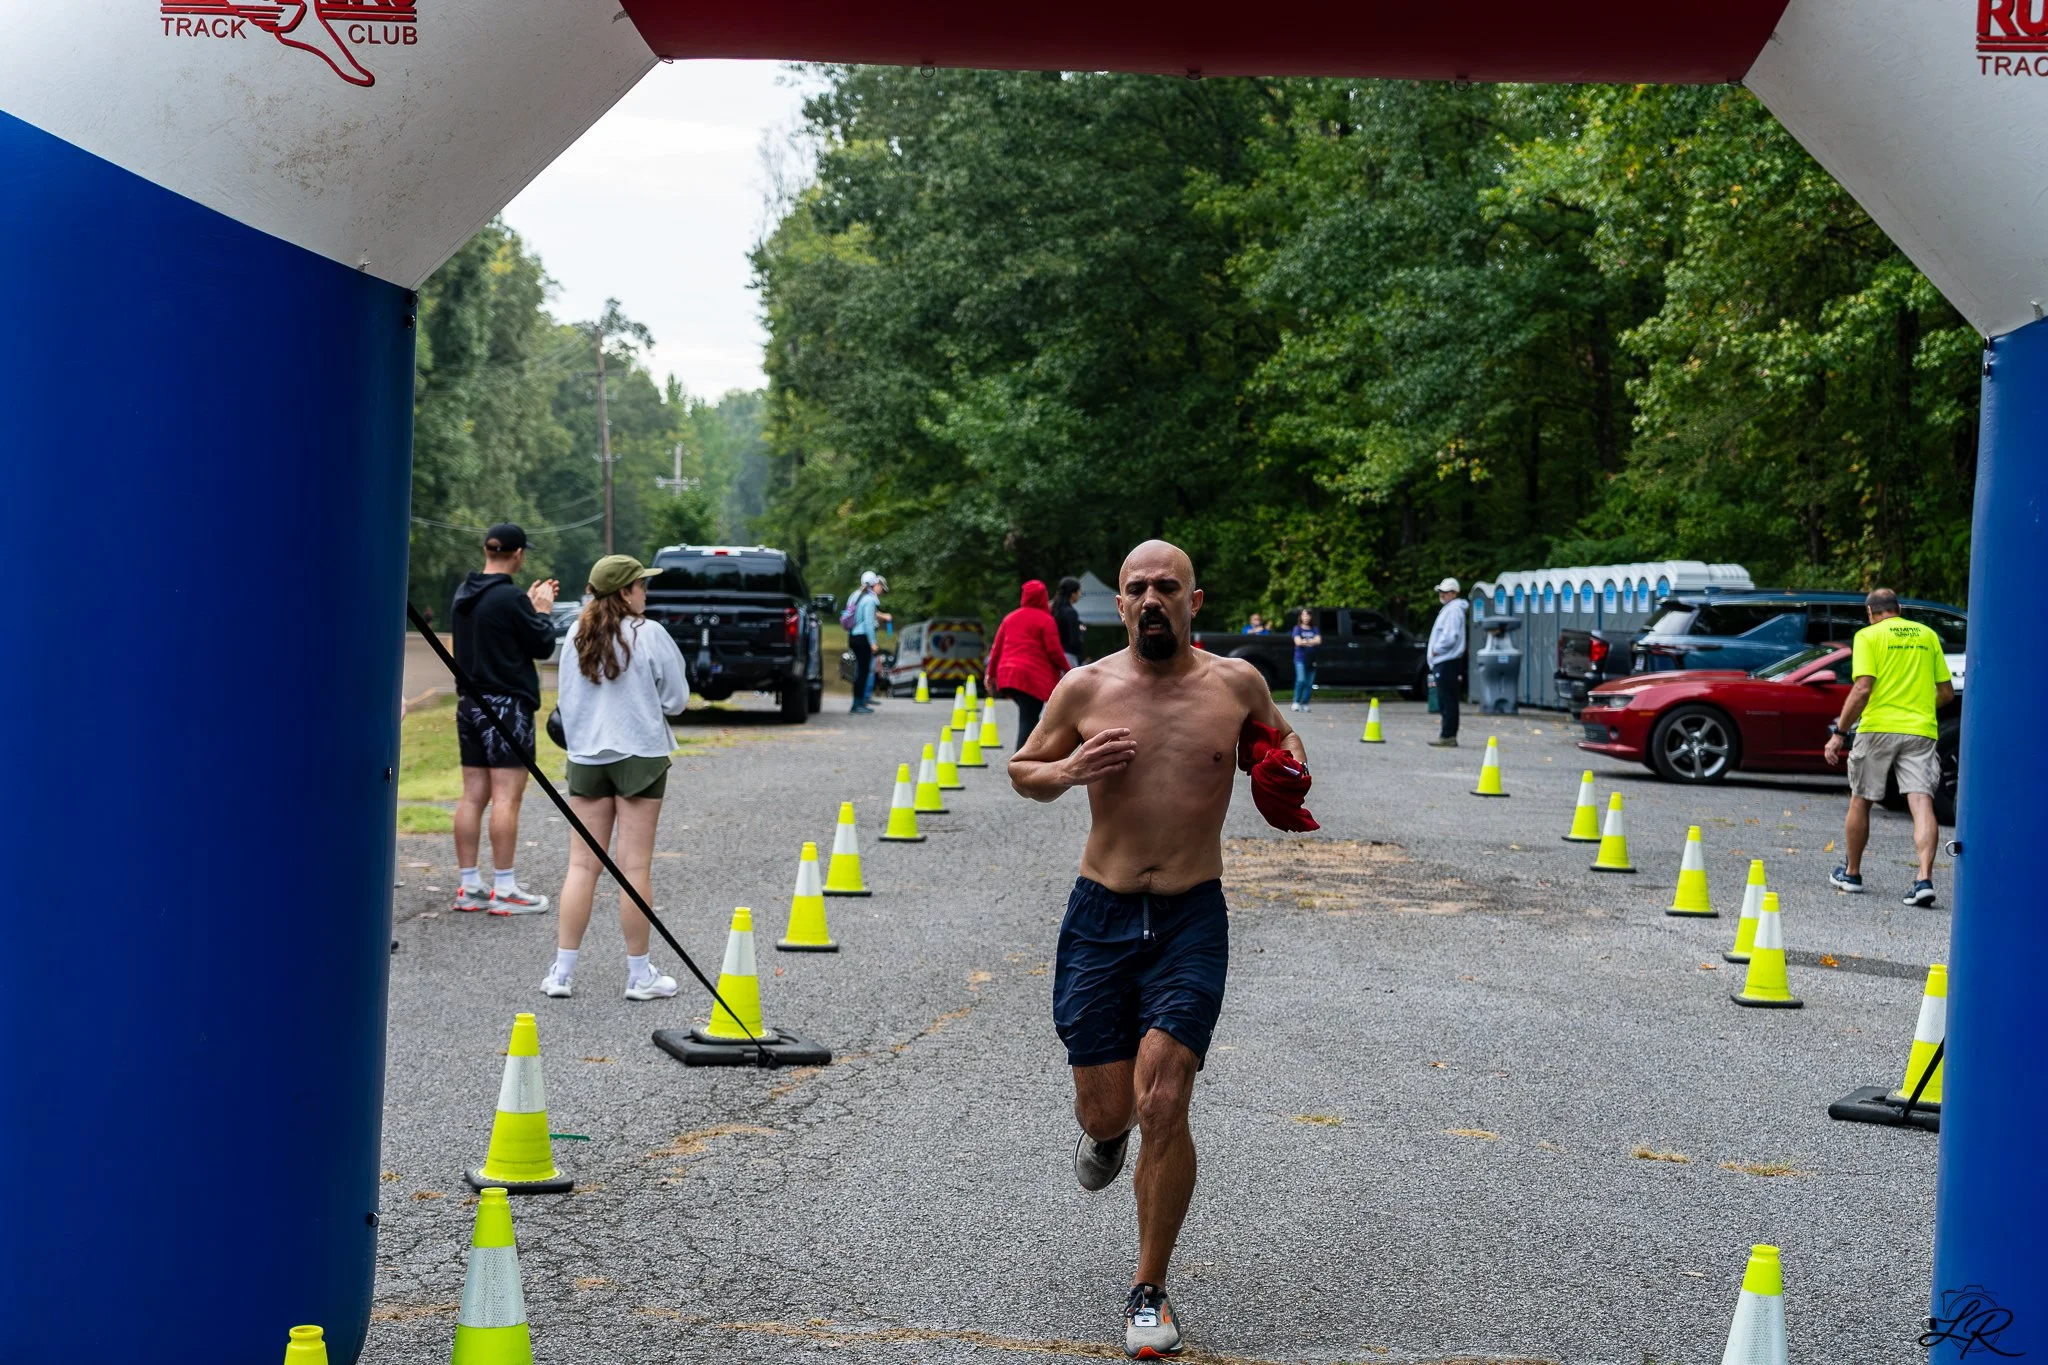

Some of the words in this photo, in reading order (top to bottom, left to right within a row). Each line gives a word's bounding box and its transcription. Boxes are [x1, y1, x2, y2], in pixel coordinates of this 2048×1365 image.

[161, 18, 246, 39] TRACK
[348, 24, 417, 44] CLUB
[1976, 55, 2048, 77] TRAC
